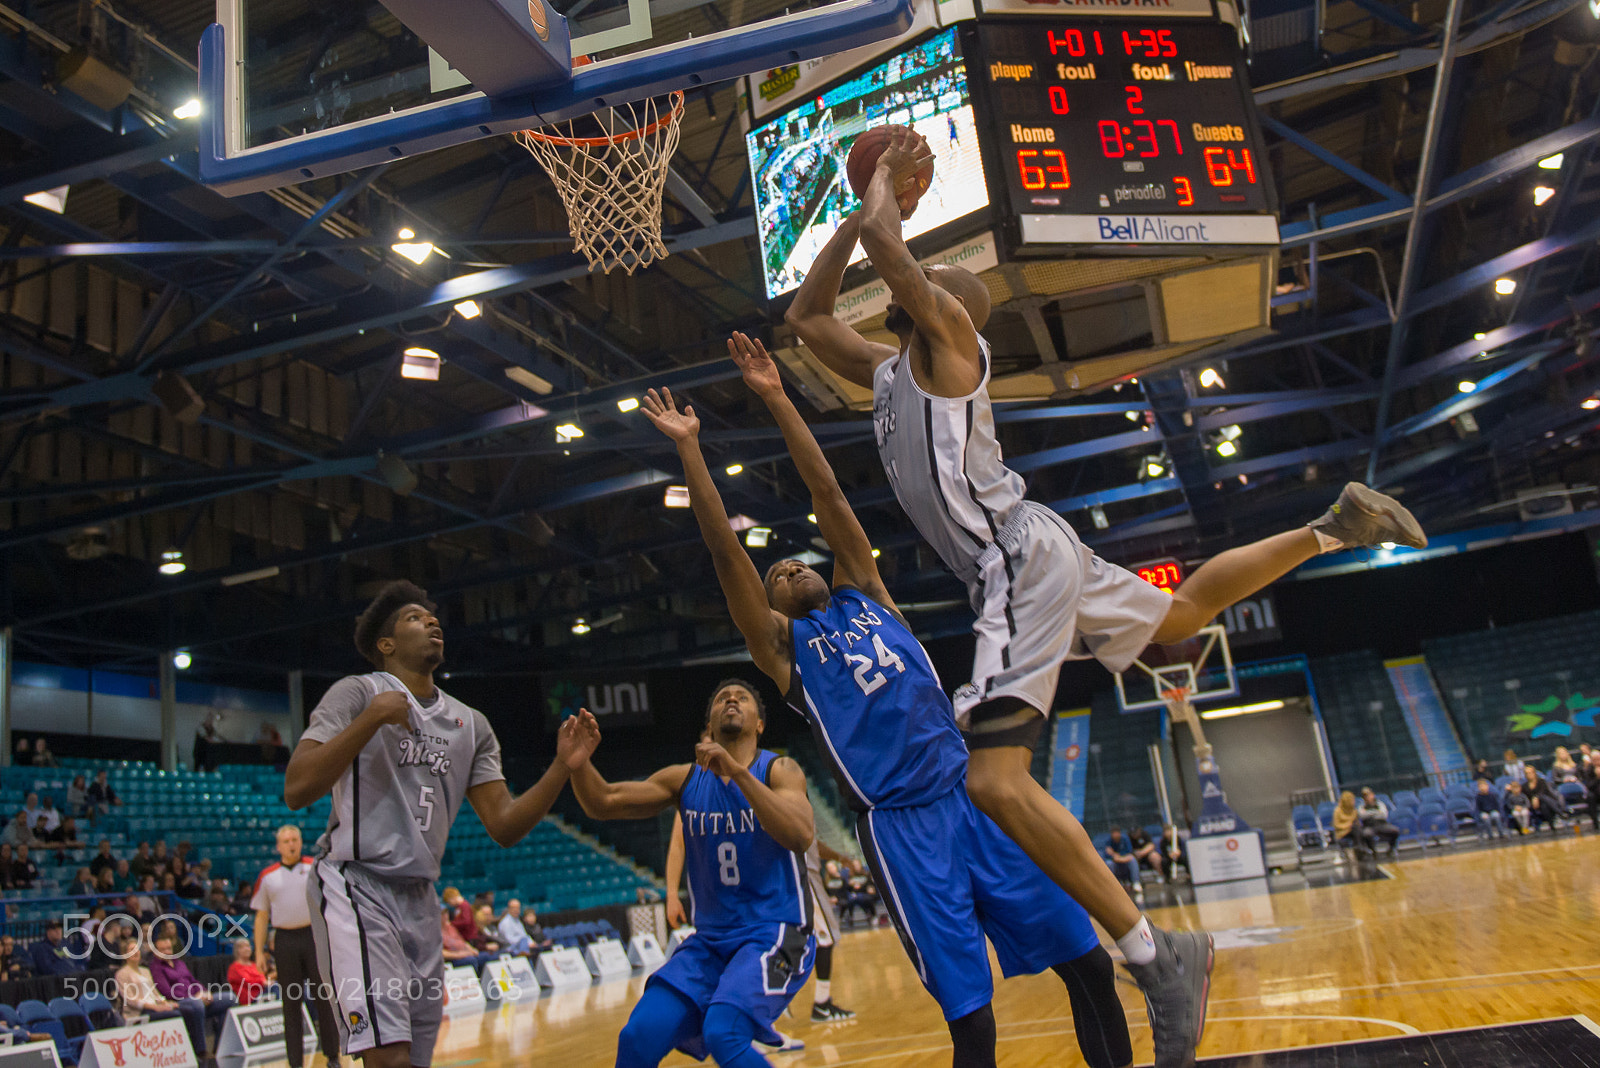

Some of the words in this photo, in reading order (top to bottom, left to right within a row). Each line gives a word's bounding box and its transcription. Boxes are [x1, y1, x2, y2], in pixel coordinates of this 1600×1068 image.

[990, 61, 1034, 82] player
[1057, 62, 1097, 80] foul
[1131, 62, 1171, 80] foul
[1048, 86, 1070, 115] 0
[1125, 85, 1145, 114] 2
[1010, 123, 1056, 143] Home
[1097, 119, 1184, 158] 8:37
[1192, 122, 1246, 142] Guests
[1017, 149, 1071, 190] 63
[1203, 146, 1257, 187] 64
[1172, 176, 1195, 206] 3
[835, 284, 886, 313] esjardins
[807, 601, 883, 665] TIANS
[843, 632, 907, 697] 24
[415, 784, 435, 832] 5
[685, 808, 764, 837] TITAN
[717, 841, 741, 887] 8
